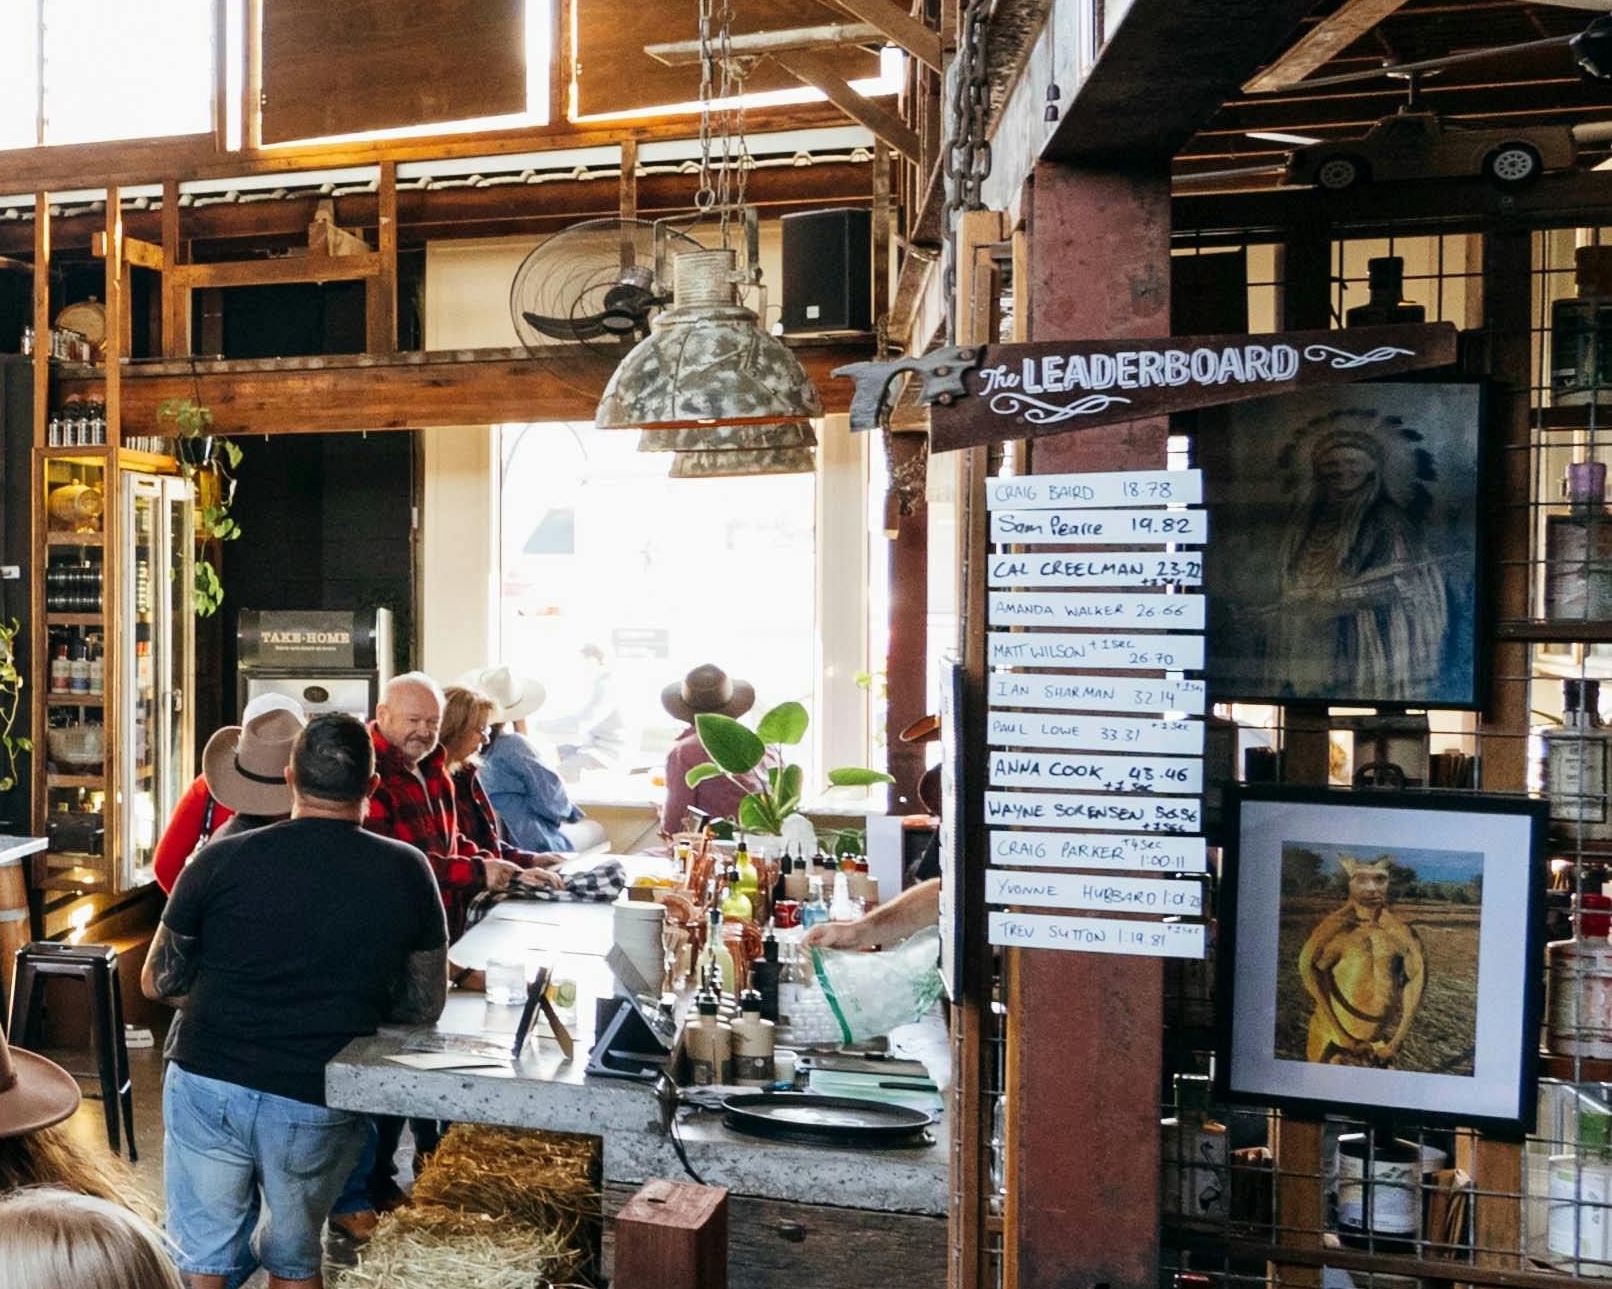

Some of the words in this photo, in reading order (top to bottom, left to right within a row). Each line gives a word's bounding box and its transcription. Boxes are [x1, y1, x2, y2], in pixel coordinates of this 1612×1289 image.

[978, 364, 1020, 396] The
[1022, 344, 1299, 394] LEADERBOARD
[995, 484, 1037, 502] CRAIG
[1049, 485, 1094, 500] BAIRD
[998, 514, 1043, 535] Sam
[1131, 517, 1192, 534] 19.82
[993, 562, 1028, 578] CAL
[1040, 560, 1144, 577] CREELMAN
[995, 600, 1054, 616] AMANDA
[1064, 603, 1124, 616] WALKER
[993, 642, 1027, 659] MATT
[1030, 644, 1086, 659] WILSON
[998, 681, 1029, 696] IAN
[1044, 686, 1116, 700] SHARMAN
[993, 720, 1027, 735] PAUL
[1041, 723, 1080, 737] LOWE
[995, 759, 1040, 777] ANNA
[1049, 761, 1104, 780] COOK
[988, 801, 1046, 818] WAYNE
[1054, 803, 1144, 821] SORENSEN
[997, 840, 1046, 858] CRAIG
[1061, 841, 1125, 860] PARKER
[998, 878, 1059, 896] YVONNE
[1083, 884, 1156, 905] HUBBARD
[999, 920, 1034, 938] TREV
[1049, 924, 1106, 943] SUTTON
